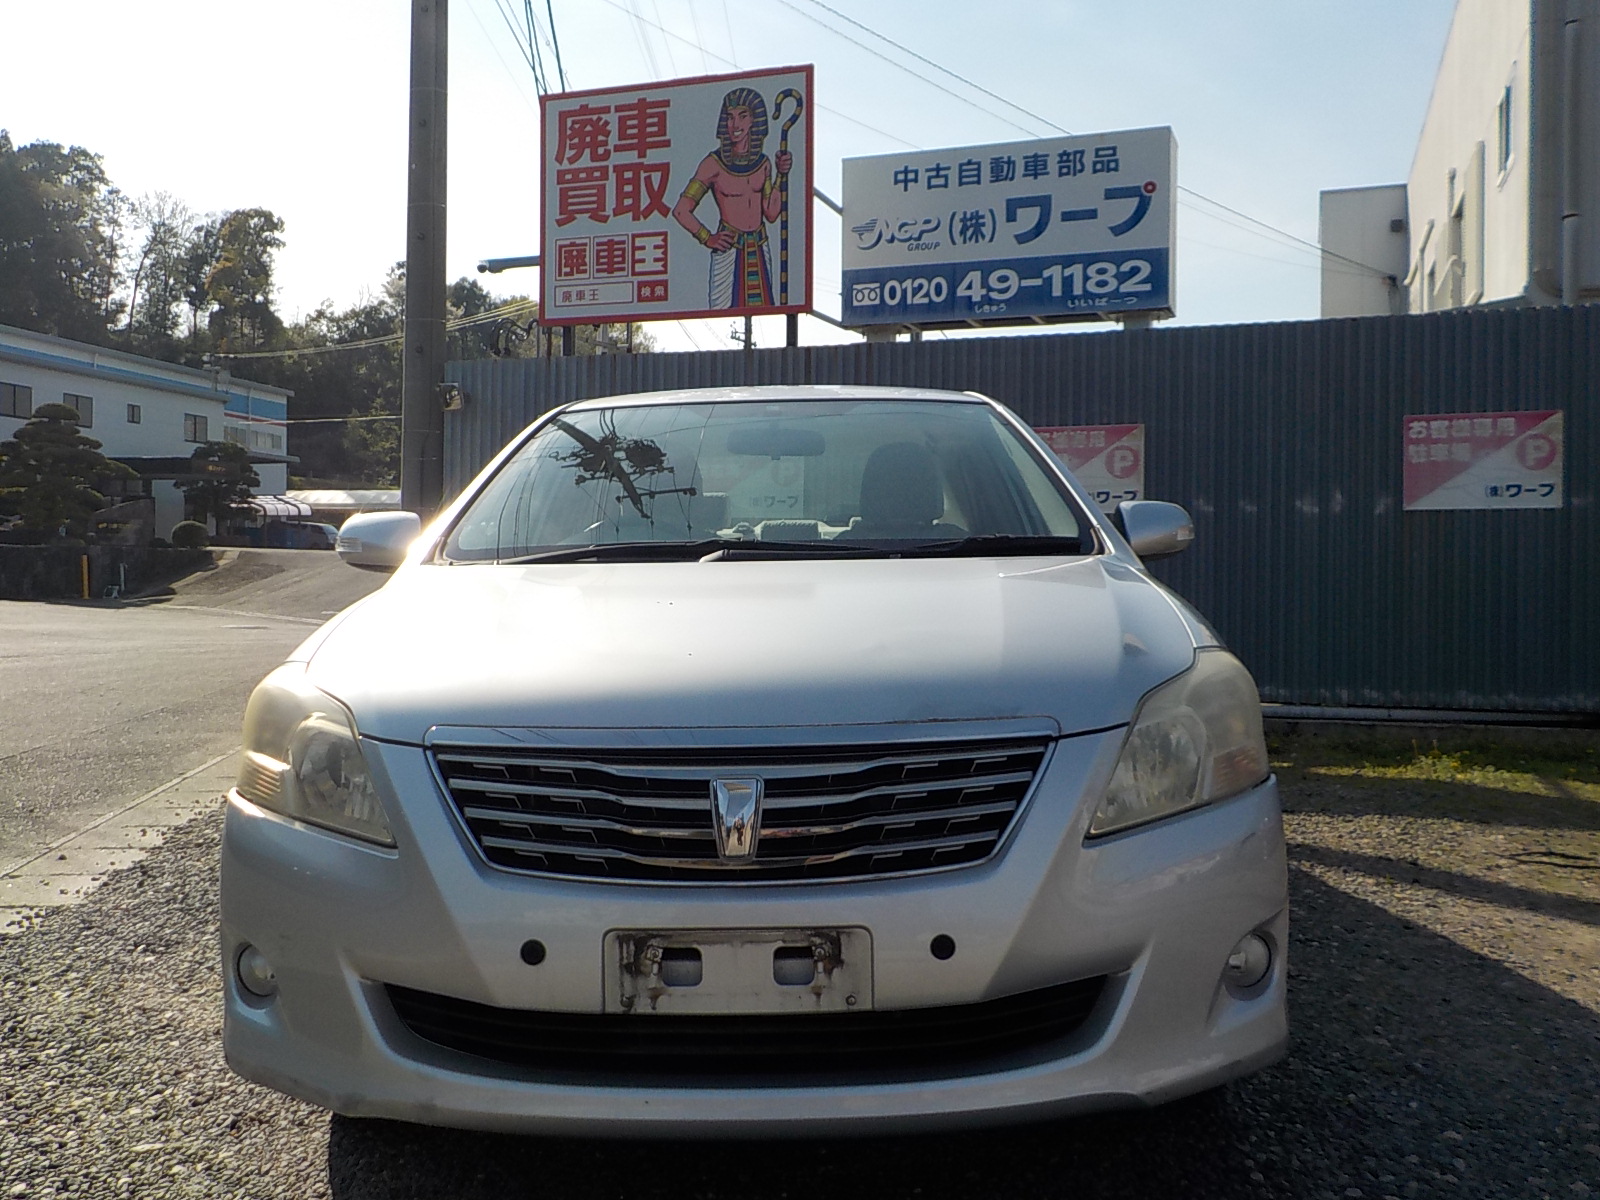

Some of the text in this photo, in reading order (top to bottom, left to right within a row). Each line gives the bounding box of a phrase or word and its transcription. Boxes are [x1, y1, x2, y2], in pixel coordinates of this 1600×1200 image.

[555, 97, 671, 165] 廃車
[893, 145, 1120, 192] 中古自動車部品
[555, 162, 671, 227] 買取
[556, 232, 668, 281] 廃車王
[907, 241, 940, 252] GROUP
[883, 259, 1152, 306] 0120 49-1182
